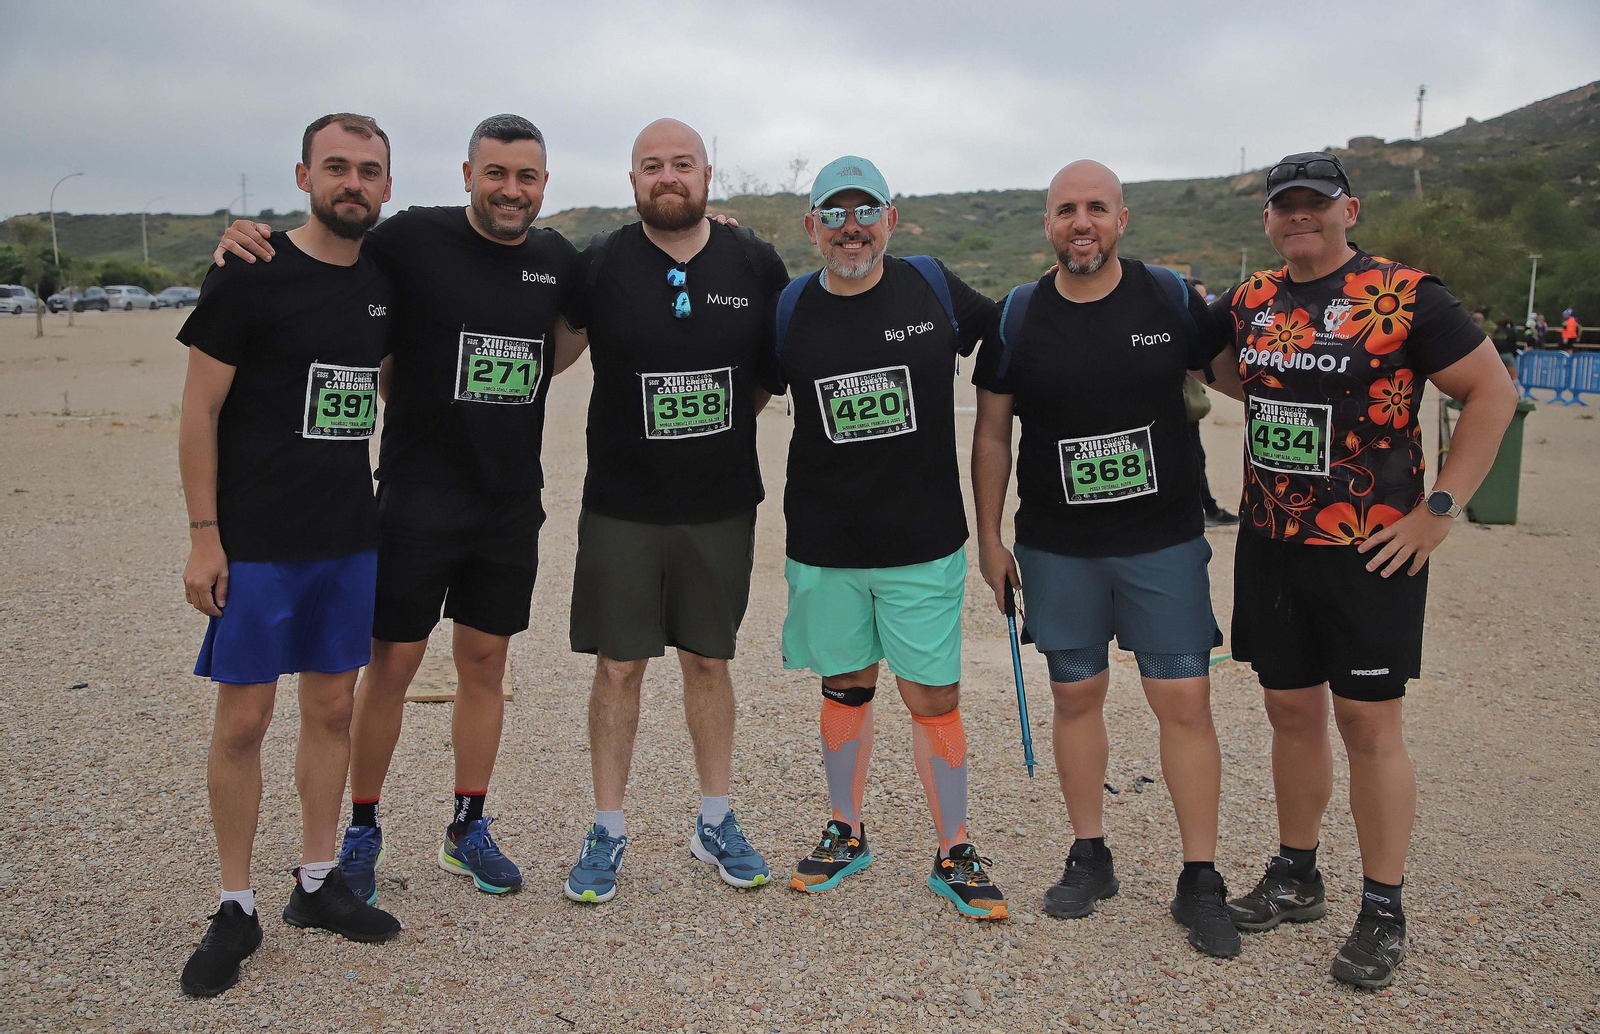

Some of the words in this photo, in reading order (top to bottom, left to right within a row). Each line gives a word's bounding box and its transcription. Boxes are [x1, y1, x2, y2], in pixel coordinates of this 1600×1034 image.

[522, 270, 556, 285] Botella
[706, 293, 749, 309] Murga
[884, 329, 905, 342] Big
[906, 321, 934, 337] Pako
[482, 337, 504, 350] XIII
[1131, 332, 1171, 347] Piano
[475, 348, 534, 360] CARBONERA
[504, 345, 529, 353] CRESTA
[1239, 347, 1351, 373] FORAJIDOS
[332, 370, 354, 382] XIII
[473, 359, 531, 386] 271
[325, 381, 375, 391] CARBONERA
[657, 382, 720, 394] CARBONERA
[662, 376, 686, 387] XIII
[685, 378, 714, 386] CRESTA
[837, 377, 860, 391] XIII
[860, 377, 889, 386] CRESTA
[833, 381, 896, 398] CARBONERA
[322, 393, 373, 419] 397
[658, 393, 721, 420] 358
[836, 392, 901, 422] 420
[1260, 403, 1279, 416] XIII
[1255, 413, 1315, 427] CARBONERA
[1279, 411, 1308, 419] CRESTA
[1078, 439, 1102, 452] XIII
[1102, 439, 1131, 449] CRESTA
[1254, 425, 1315, 454] 434
[1074, 443, 1139, 460] CARBONERA
[1076, 454, 1142, 485] 368
[1350, 668, 1390, 676] PROZIS
